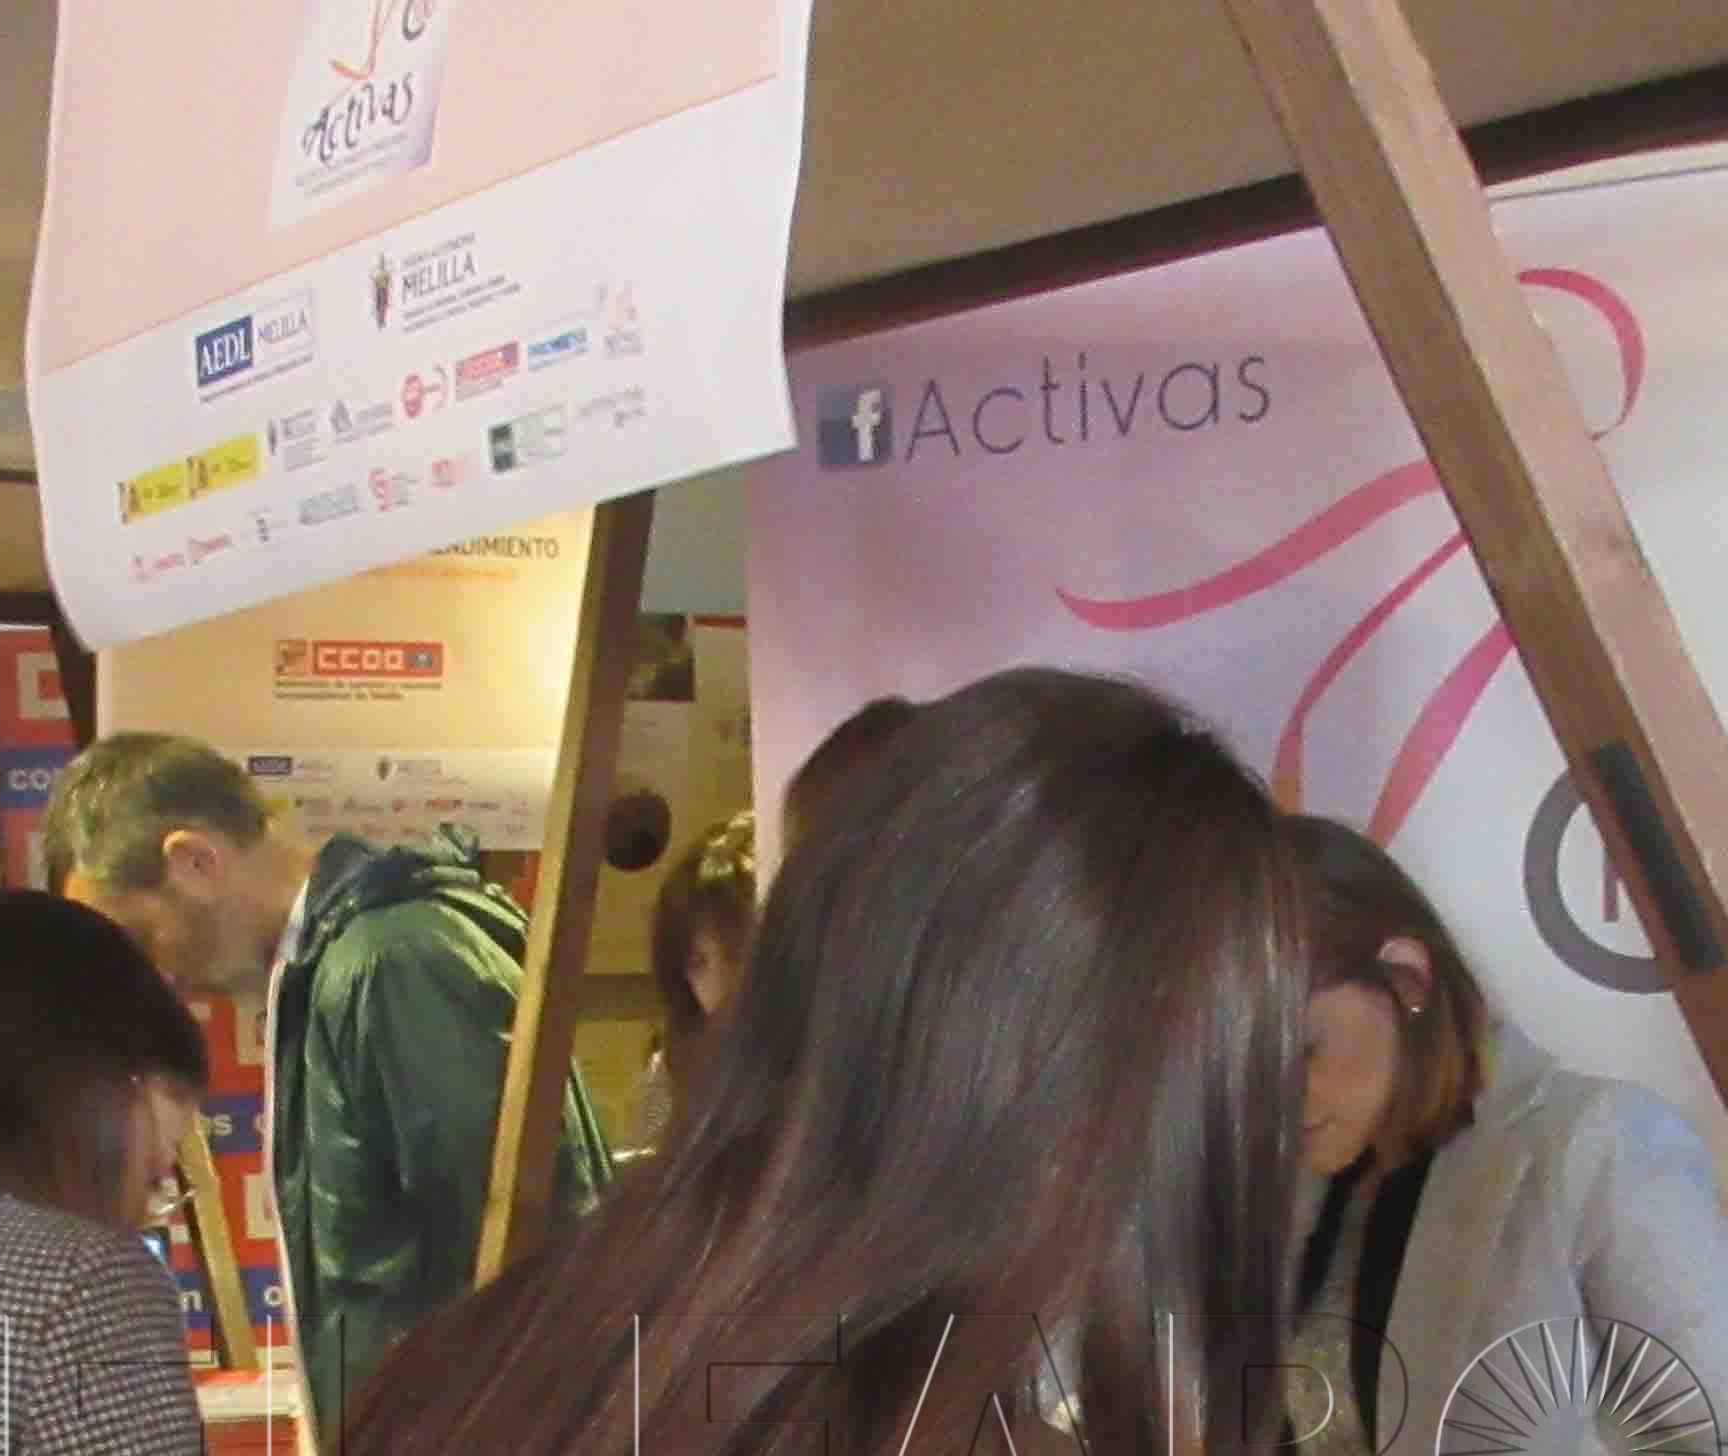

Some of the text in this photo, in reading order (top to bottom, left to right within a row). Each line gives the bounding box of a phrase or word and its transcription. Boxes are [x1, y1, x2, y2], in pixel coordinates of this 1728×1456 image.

[402, 251, 476, 303] MELILLA
[200, 327, 251, 377] AEDL
[904, 352, 1271, 463] Activas
[318, 647, 404, 671] CCOO
